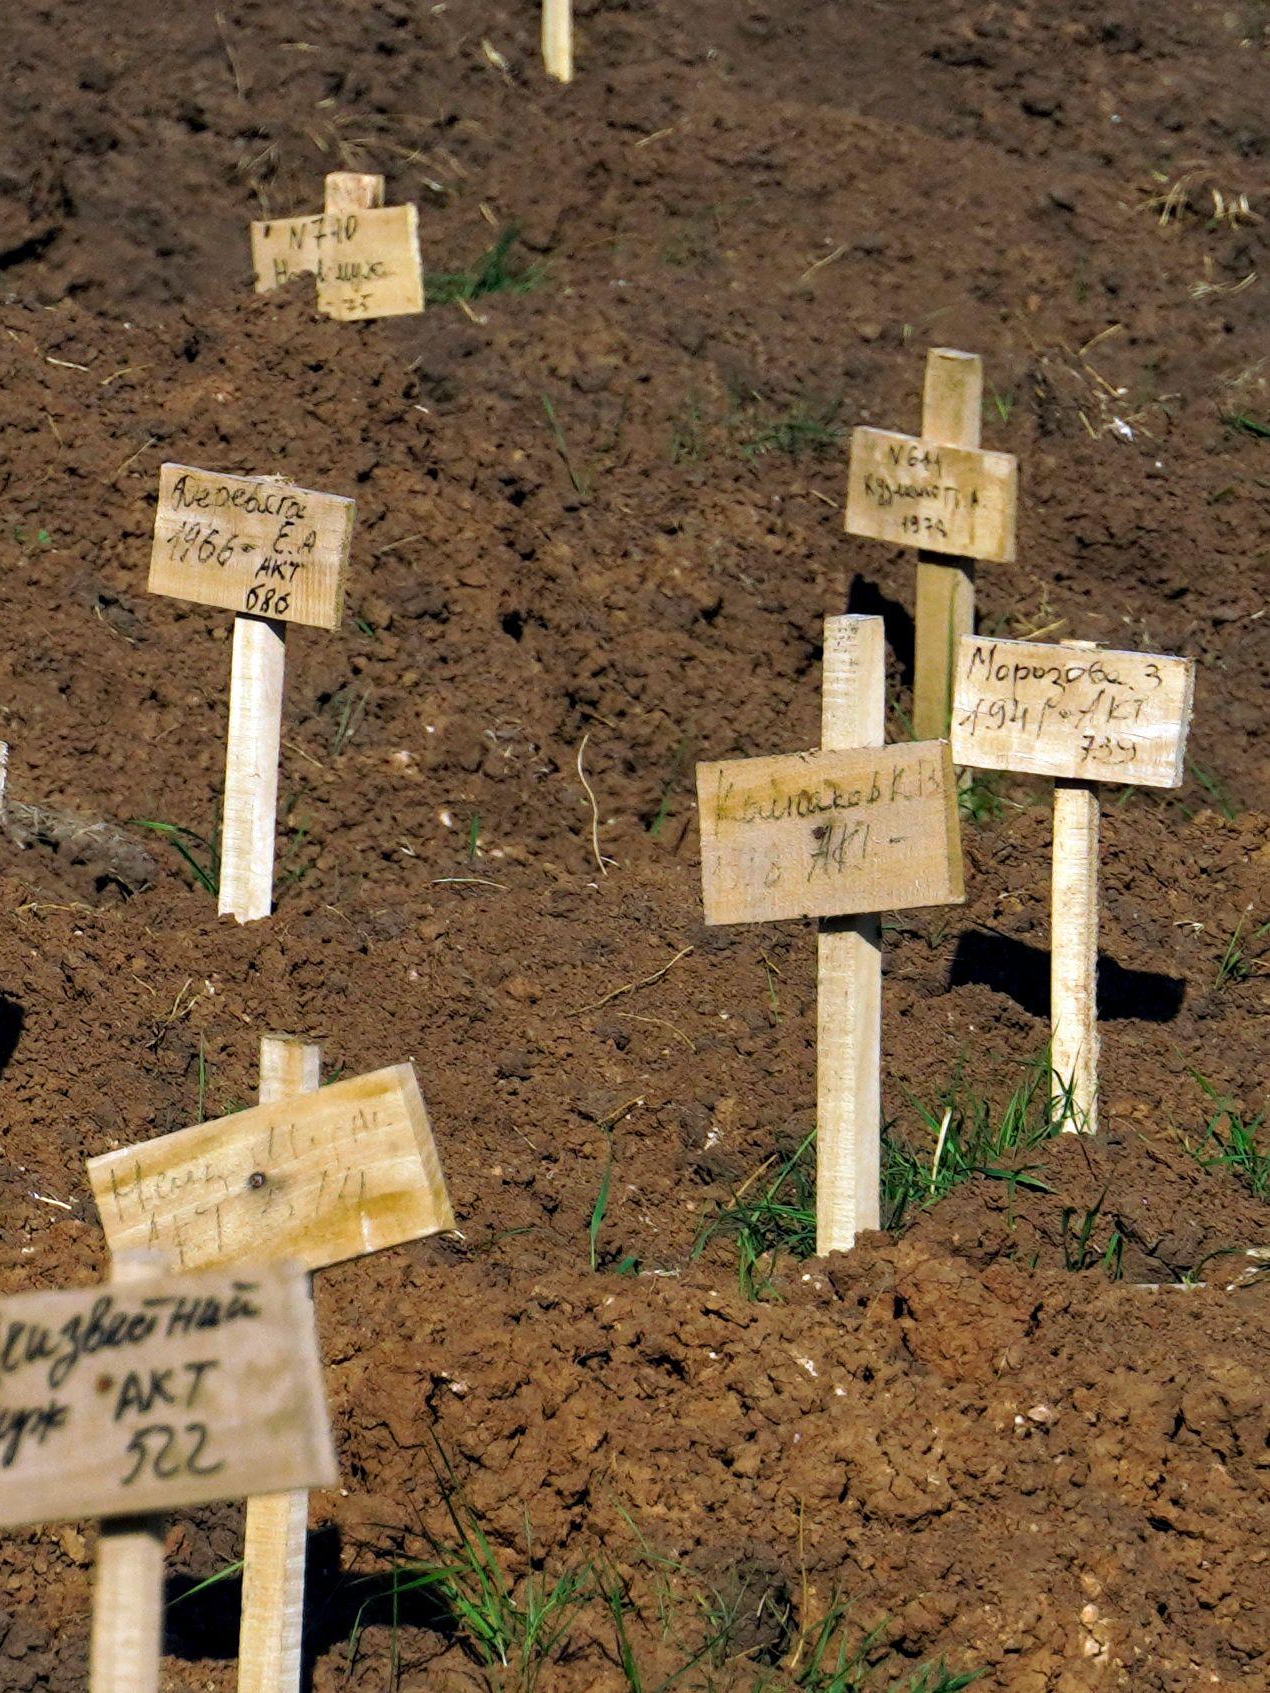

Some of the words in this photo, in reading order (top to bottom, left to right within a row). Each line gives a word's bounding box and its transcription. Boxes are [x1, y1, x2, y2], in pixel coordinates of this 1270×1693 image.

[254, 555, 306, 583] АКТ
[245, 583, 292, 615] 686
[113, 1359, 220, 1423] АКТ
[121, 1422, 224, 1487] 522
